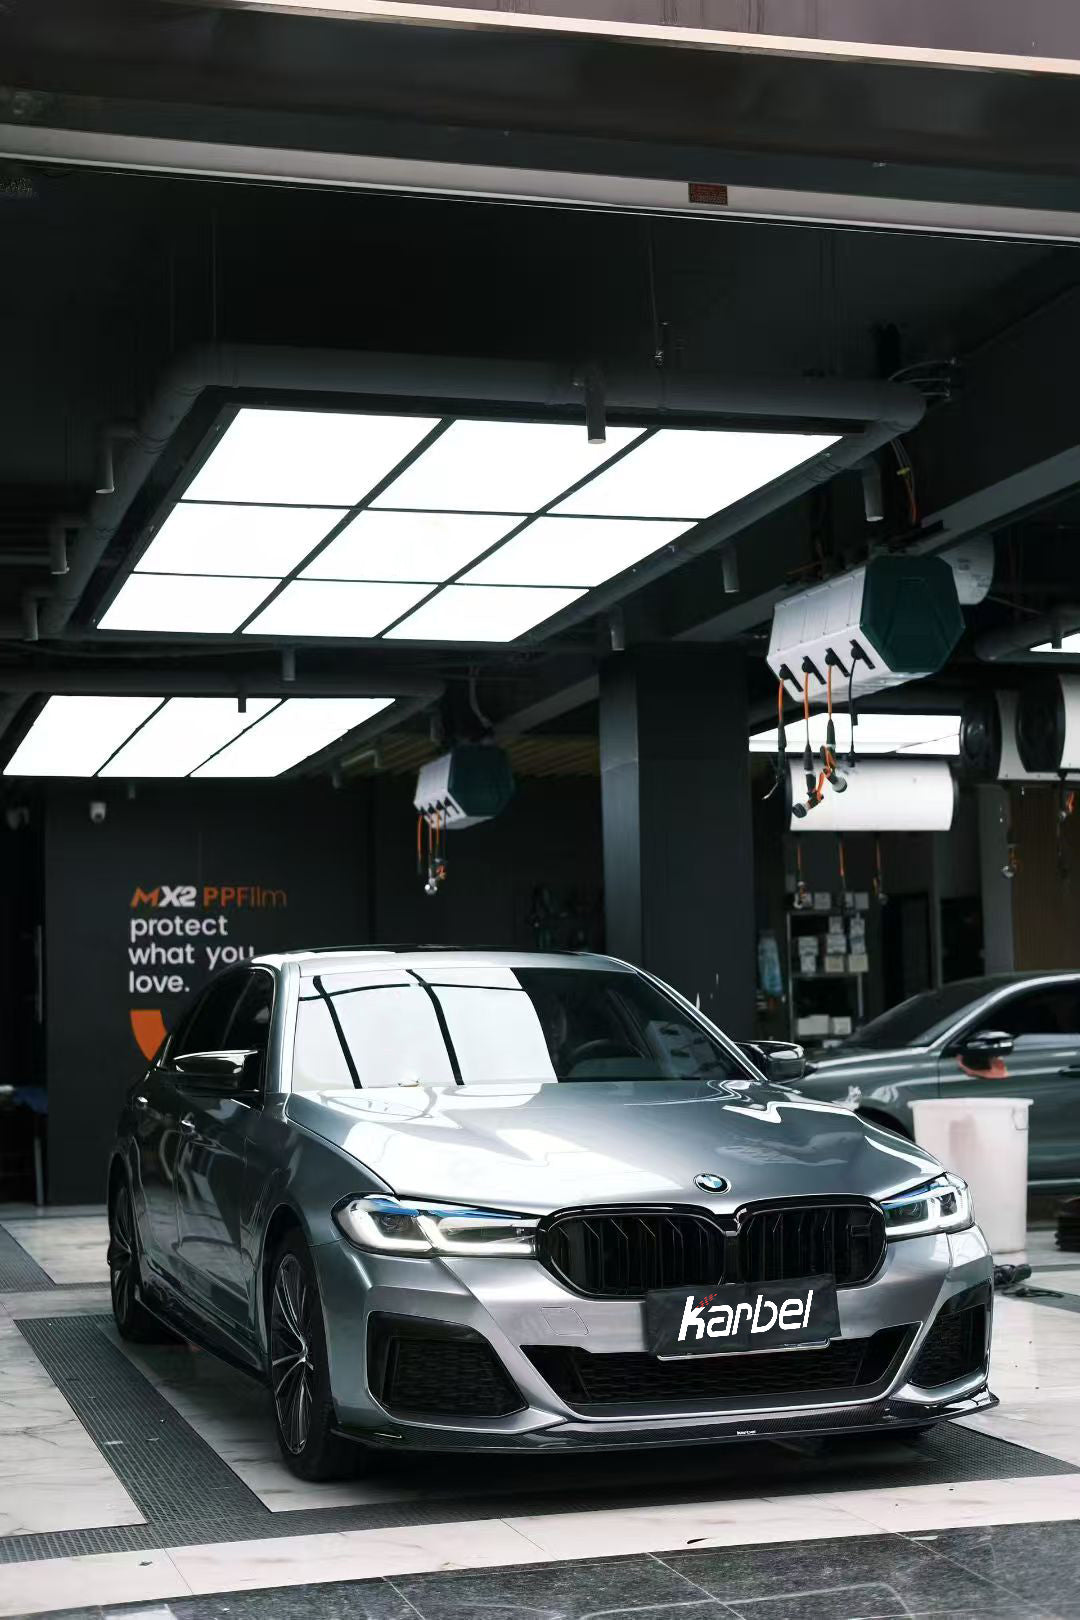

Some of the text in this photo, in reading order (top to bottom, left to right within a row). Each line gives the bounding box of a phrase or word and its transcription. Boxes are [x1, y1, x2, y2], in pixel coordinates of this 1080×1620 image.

[131, 886, 197, 907] MX2
[130, 915, 228, 943] protect
[128, 943, 254, 971] what you
[129, 971, 190, 993] love.
[678, 1290, 814, 1341] karbel
